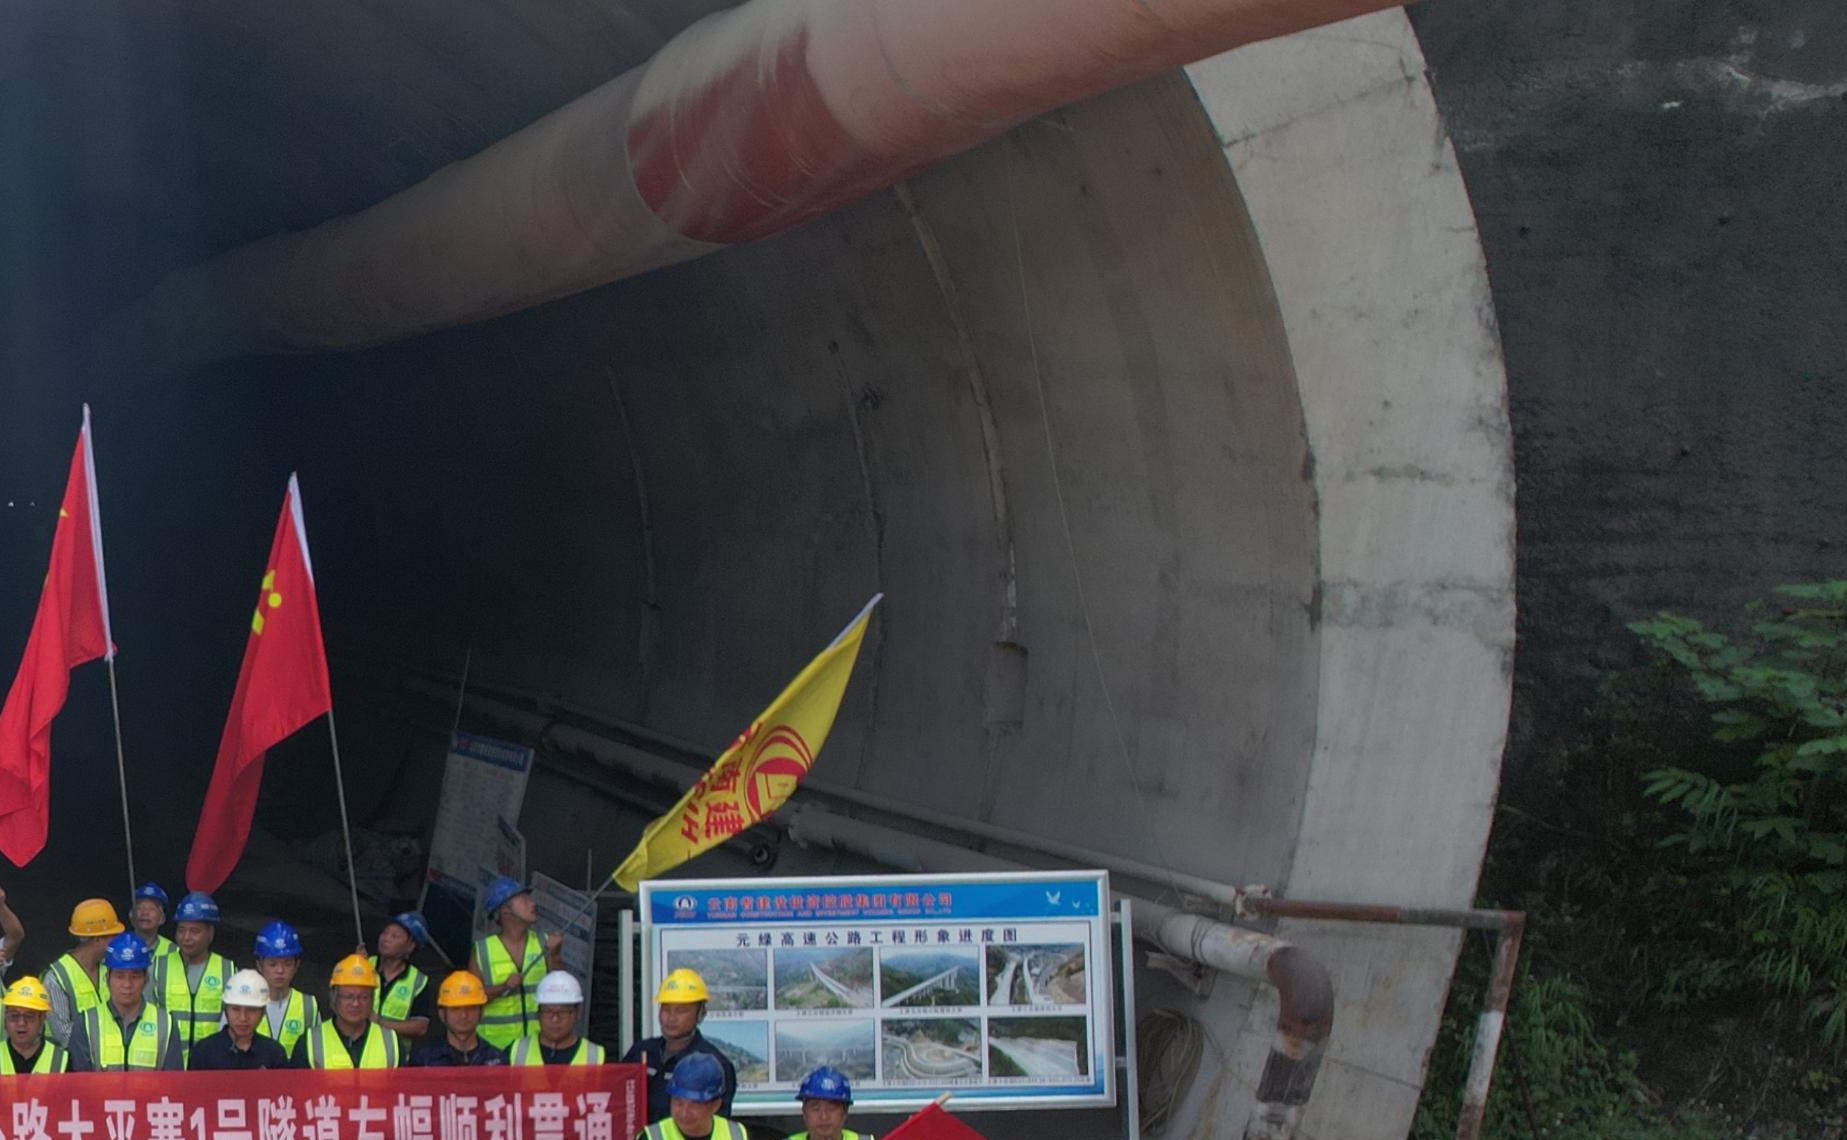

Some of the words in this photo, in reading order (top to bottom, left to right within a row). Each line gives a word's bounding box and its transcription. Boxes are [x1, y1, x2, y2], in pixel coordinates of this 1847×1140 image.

[736, 928, 1018, 947] 元绿高速公路工程形象进度图
